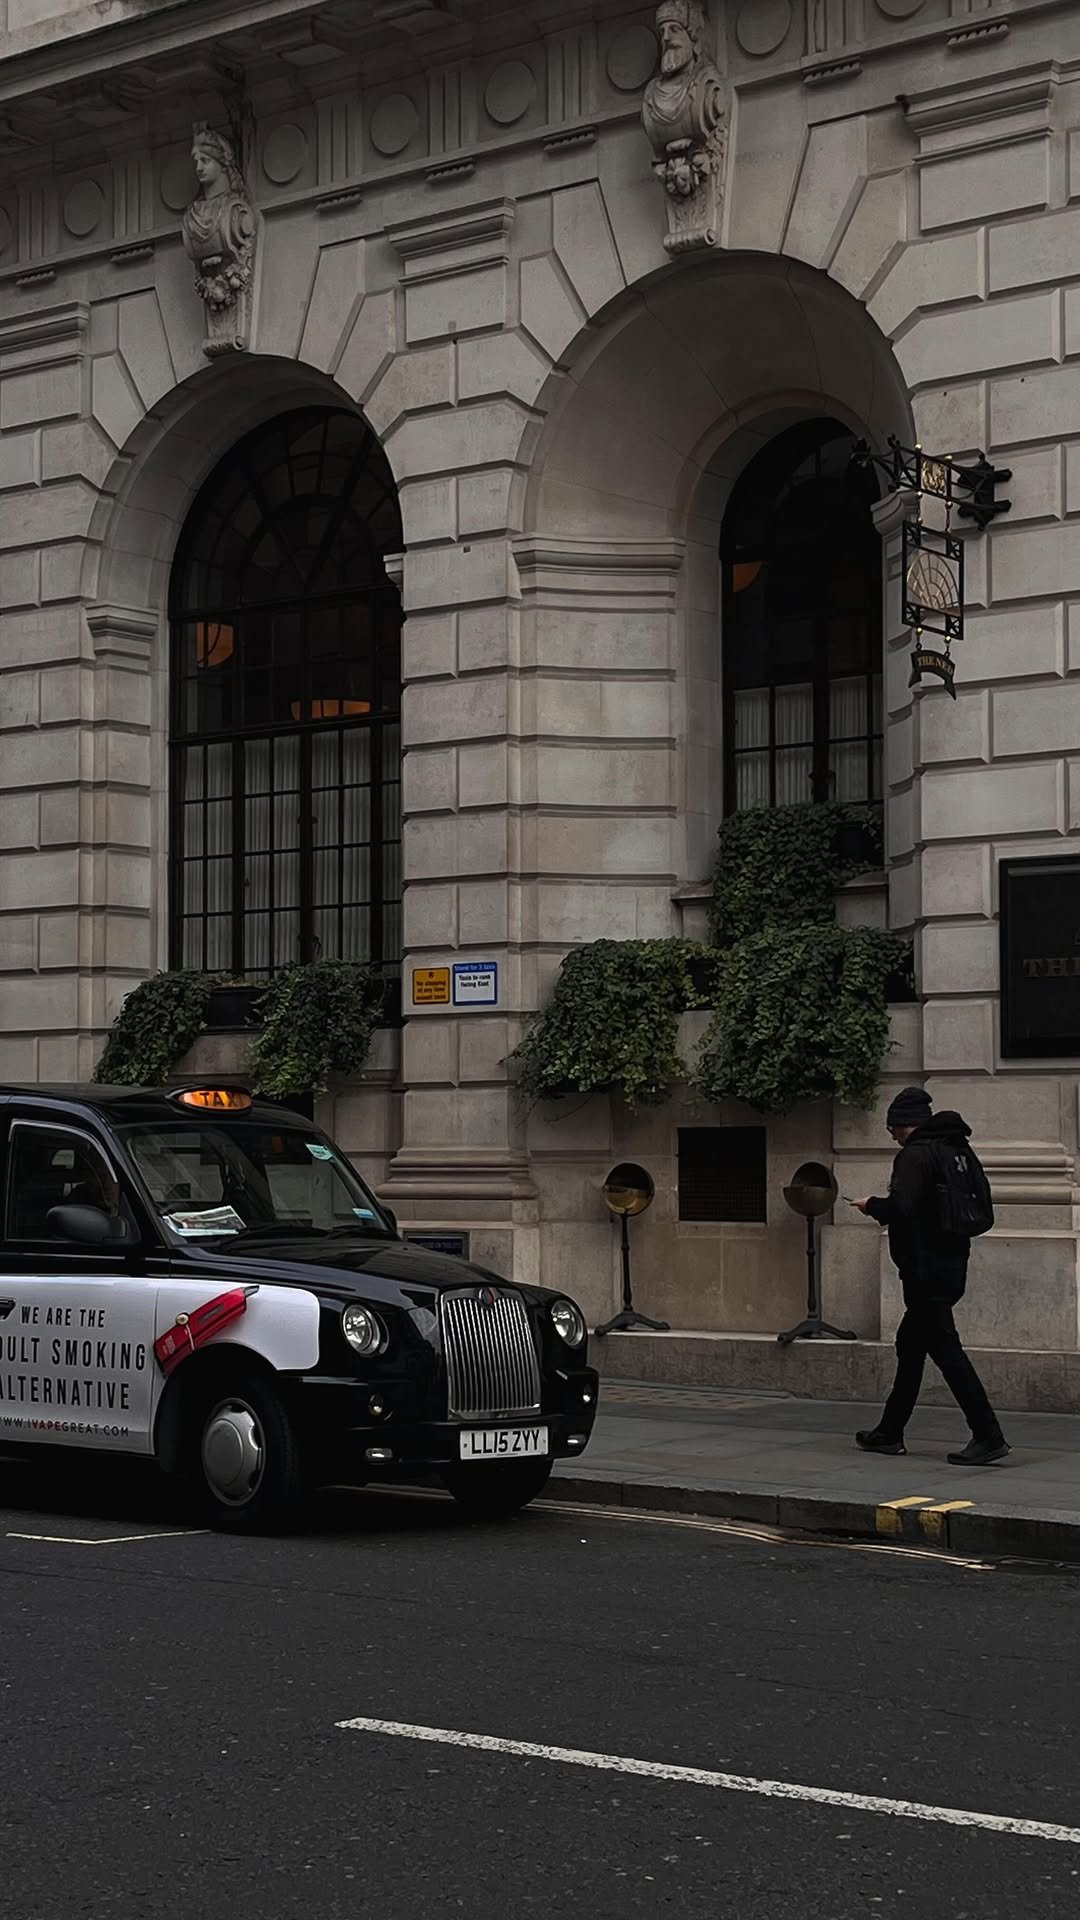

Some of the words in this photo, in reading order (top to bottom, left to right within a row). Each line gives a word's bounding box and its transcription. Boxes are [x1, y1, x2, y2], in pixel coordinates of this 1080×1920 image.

[917, 655, 936, 667] THE
[21, 1306, 40, 1324] WE
[46, 1307, 72, 1326] ARE
[80, 1309, 105, 1328] THE
[52, 1339, 146, 1371] SMOKING
[471, 1431, 508, 1454] LL15
[512, 1429, 540, 1452] ZYY
